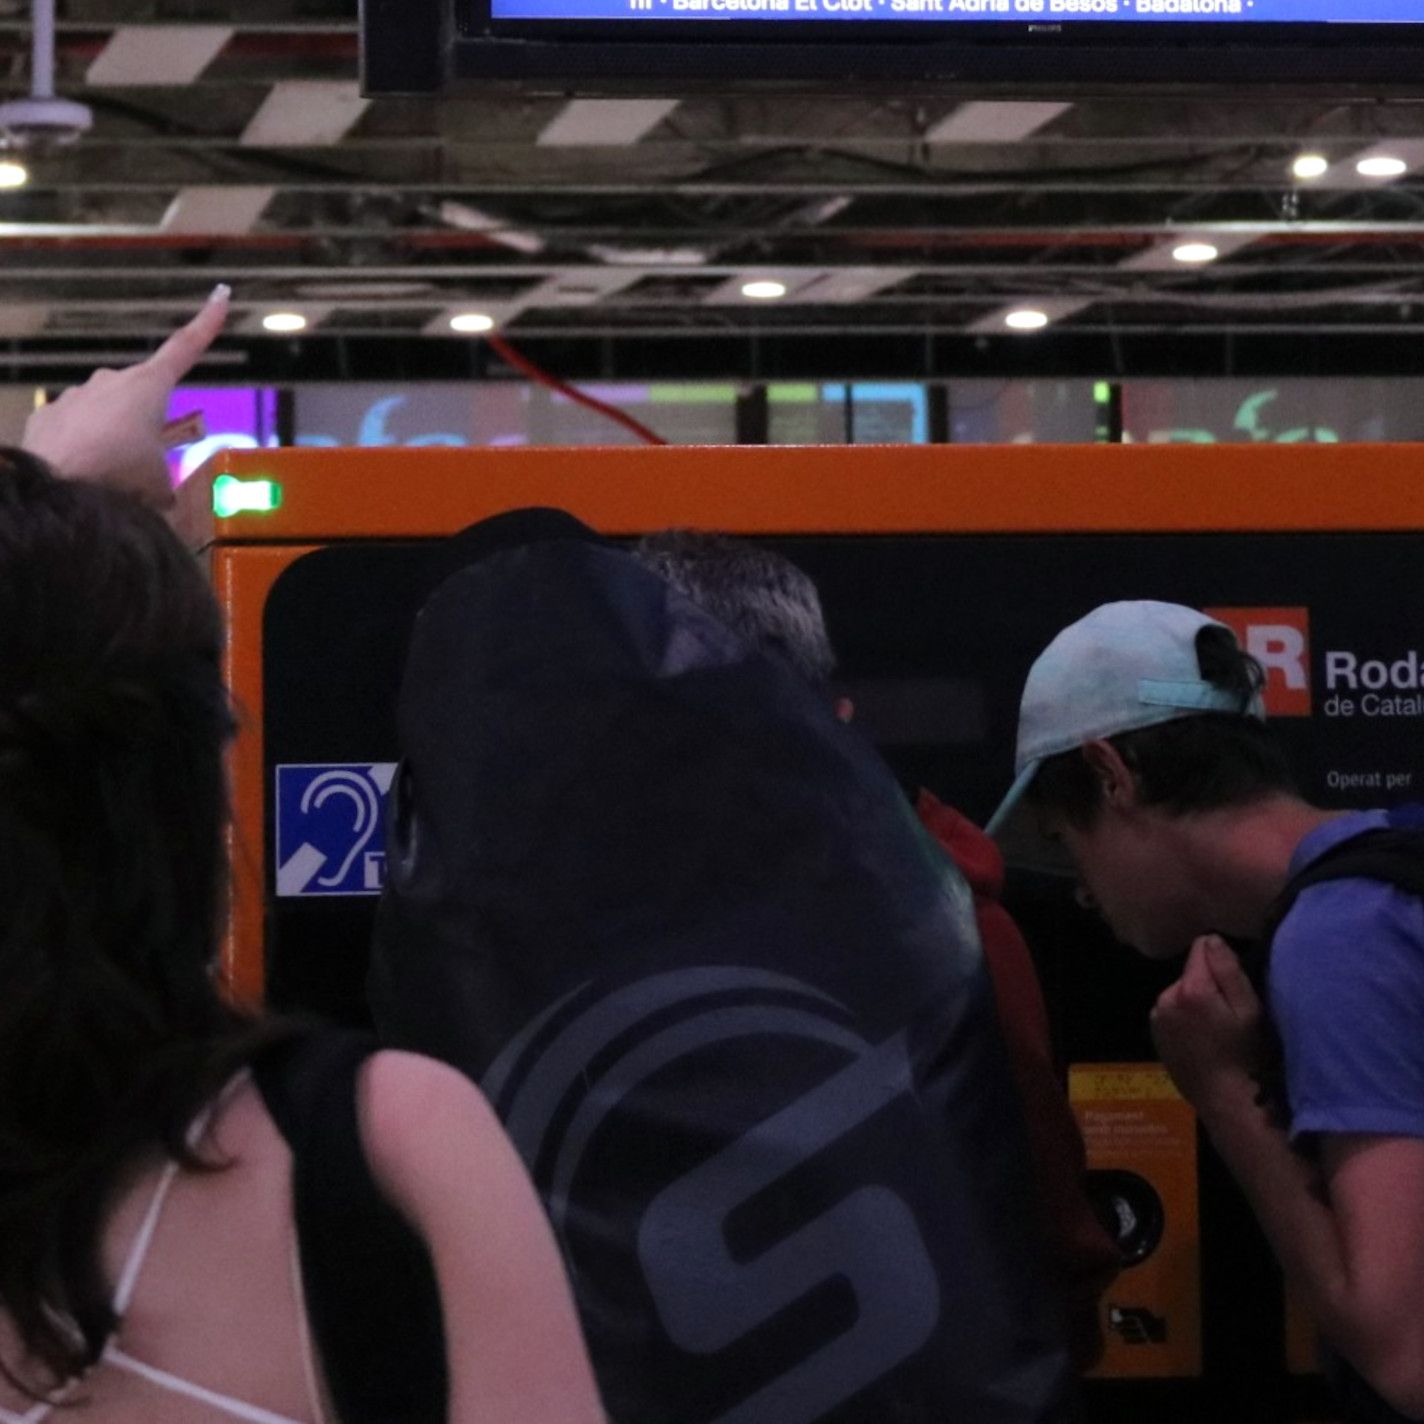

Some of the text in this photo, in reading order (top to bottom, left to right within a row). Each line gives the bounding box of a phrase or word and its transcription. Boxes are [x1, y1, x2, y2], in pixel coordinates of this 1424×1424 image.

[1246, 624, 1307, 689] R
[1324, 695, 1355, 716] de
[1326, 770, 1383, 791] Operat
